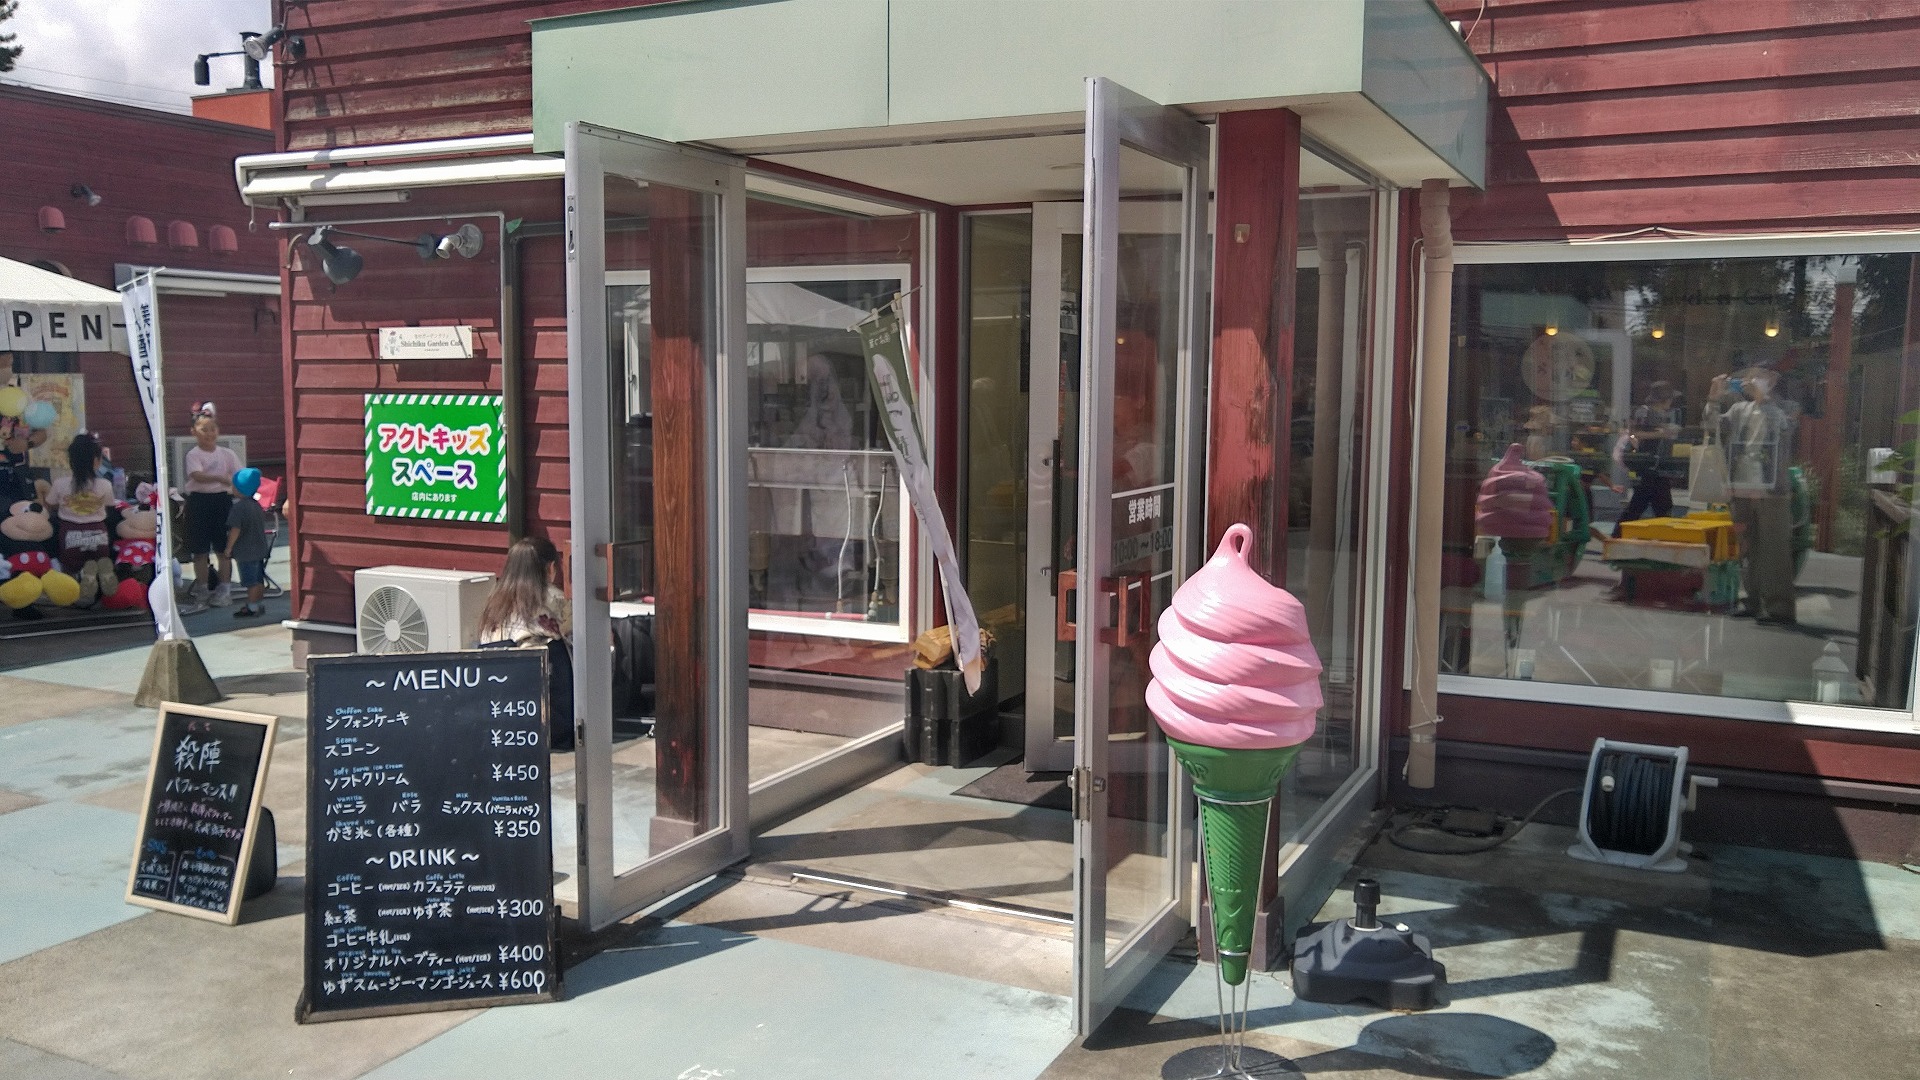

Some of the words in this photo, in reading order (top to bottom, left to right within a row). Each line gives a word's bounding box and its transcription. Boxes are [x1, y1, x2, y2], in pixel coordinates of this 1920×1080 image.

[379, 424, 491, 453] アクトキッズ
[393, 459, 475, 489] スペース
[411, 491, 458, 503] 店内にあります
[1128, 495, 1161, 525] 営業時間
[325, 711, 410, 731] シフォンケーキ
[490, 700, 537, 718] ¥450
[174, 734, 222, 774] 殺陣
[324, 742, 380, 759] スコーン
[491, 729, 539, 748] ¥250
[324, 772, 410, 791] ソフトクリーム
[492, 763, 539, 782] ¥450
[326, 800, 368, 816] バニラ
[392, 799, 422, 814] バラ
[494, 820, 541, 838] ¥350
[327, 882, 375, 898] コーヒー
[412, 880, 465, 897] カフェラテ
[323, 908, 358, 927] 紅茶
[412, 902, 453, 920] ゆず茶
[496, 899, 544, 919] ¥300
[324, 950, 452, 972] オリジナルハーブティー
[498, 944, 544, 965] ¥400
[498, 970, 546, 995] ¥600
